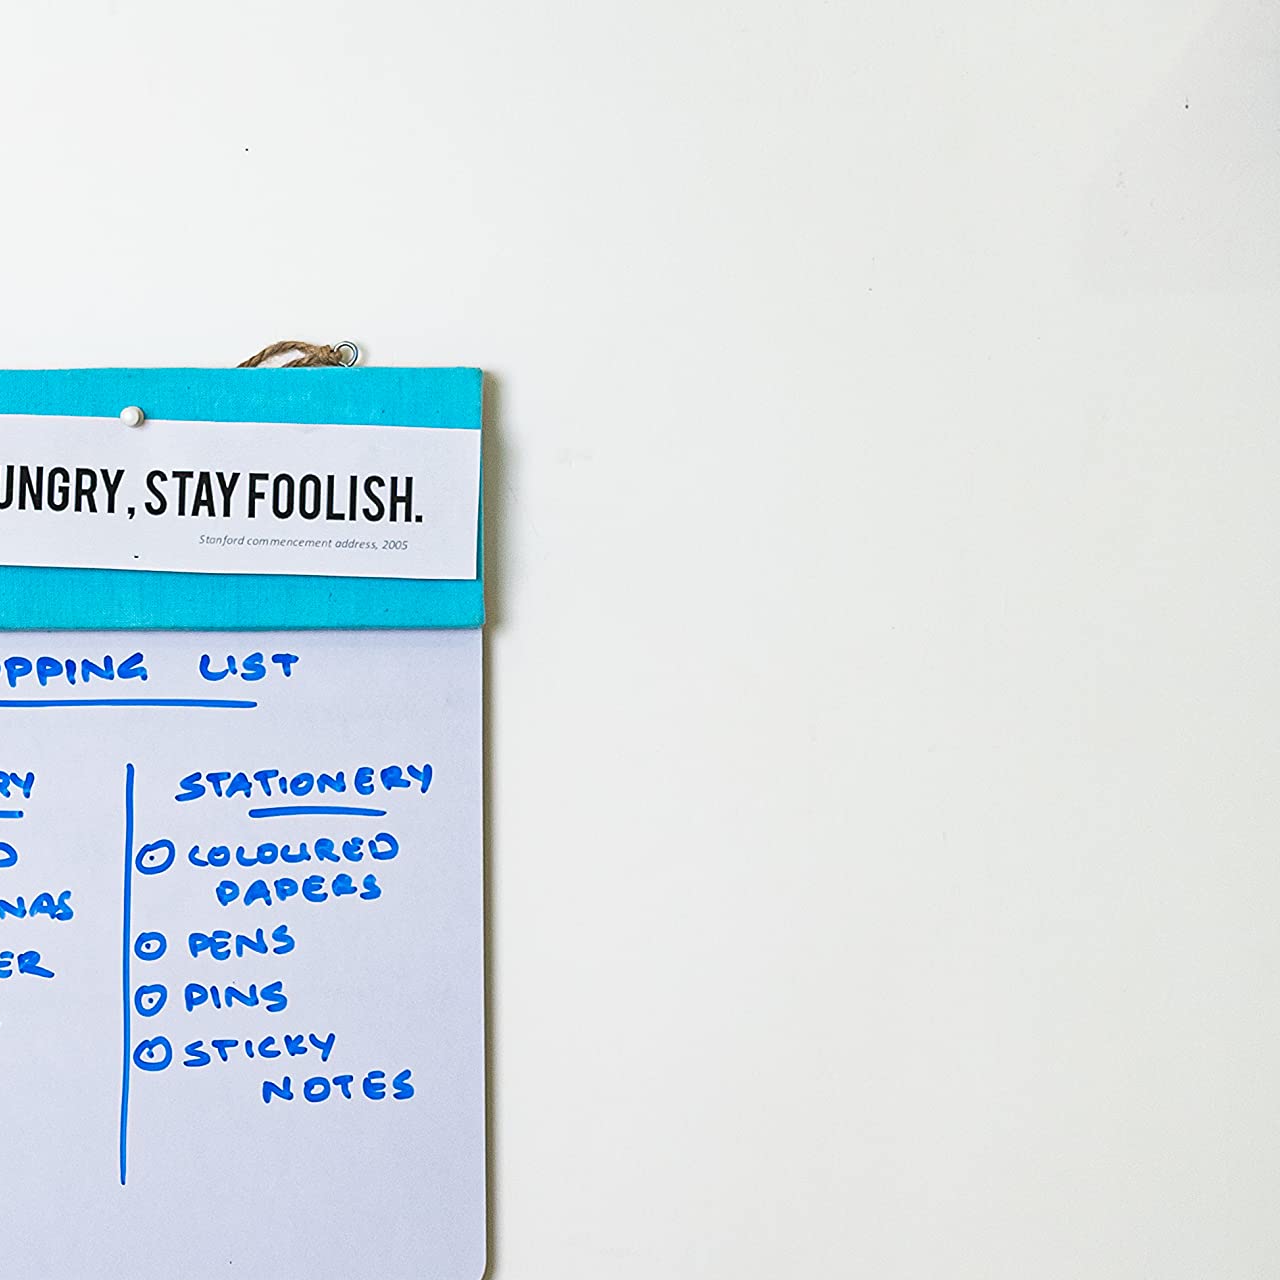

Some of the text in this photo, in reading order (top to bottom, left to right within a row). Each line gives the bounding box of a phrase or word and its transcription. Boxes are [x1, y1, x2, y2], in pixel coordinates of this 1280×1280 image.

[144, 469, 241, 518] STAY
[247, 472, 424, 524] FOOLISH.
[198, 534, 409, 551] Stanford commencement address, 2005
[198, 651, 300, 682] LIST
[175, 763, 433, 803] STATIONERY
[187, 832, 400, 868] COLOURED
[215, 872, 382, 907] PAPERS
[187, 924, 296, 961] PENS
[184, 980, 288, 1013] PINS
[183, 1032, 336, 1068] STICKY
[261, 1068, 415, 1104] NOTES
